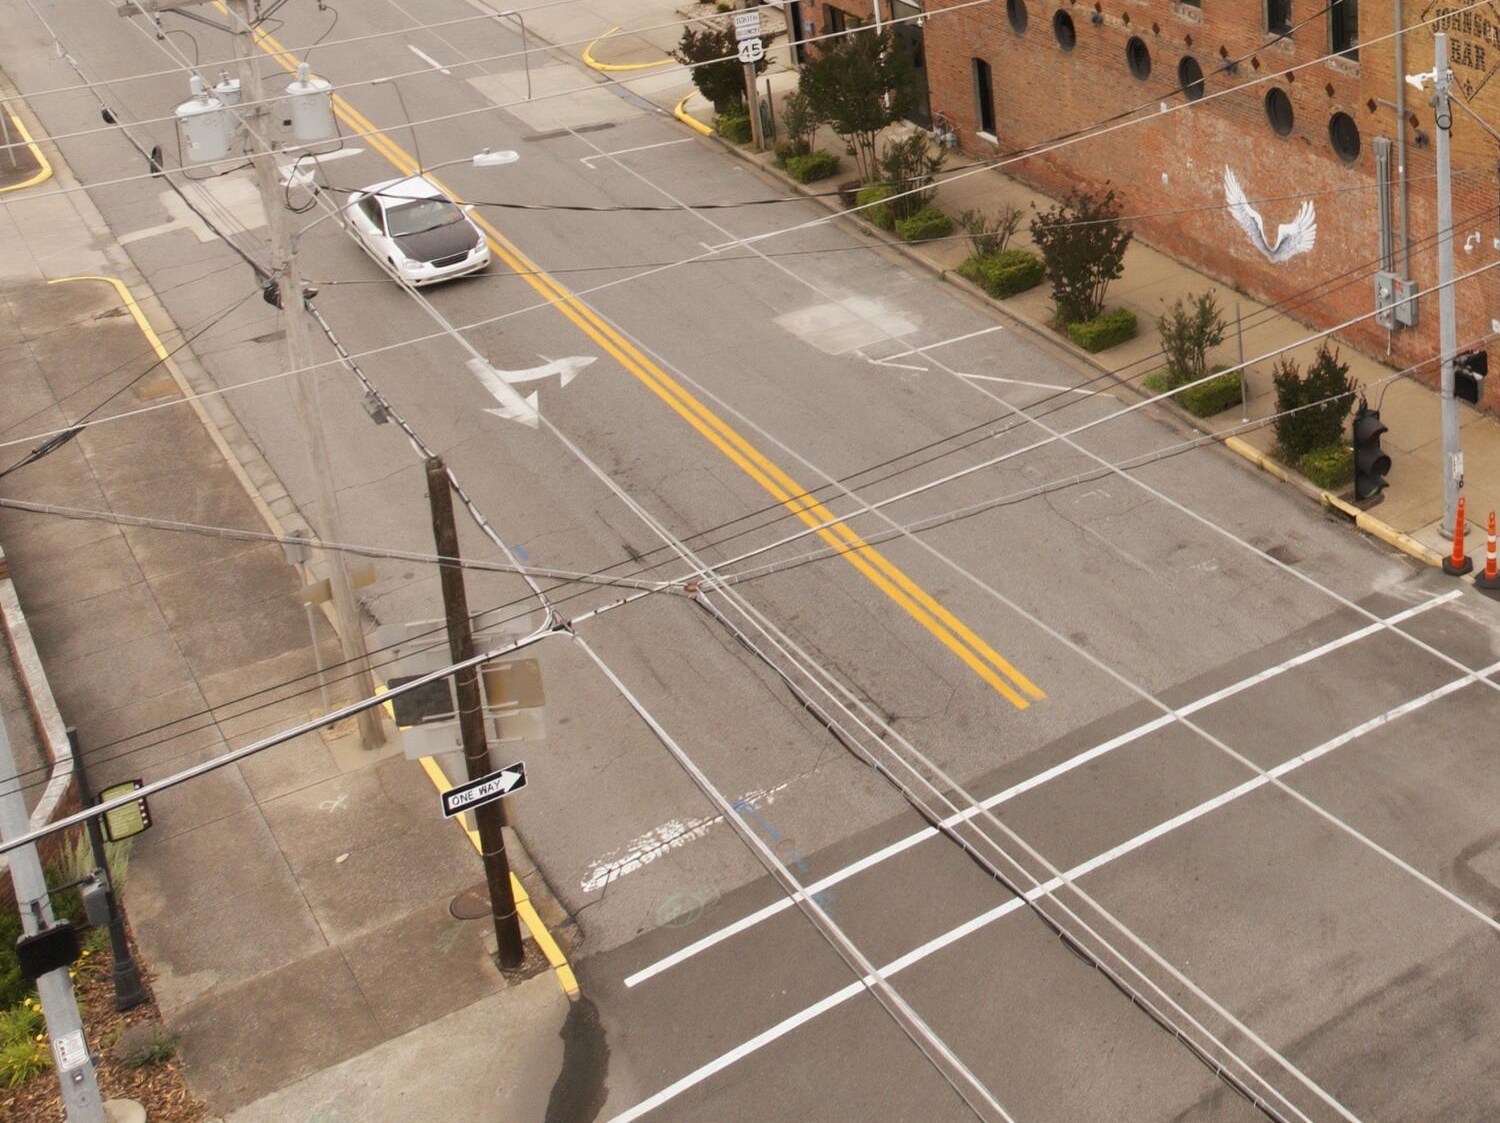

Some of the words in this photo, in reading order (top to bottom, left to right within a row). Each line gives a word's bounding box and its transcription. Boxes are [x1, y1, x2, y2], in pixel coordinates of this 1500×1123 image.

[742, 43, 761, 57] 45
[1450, 37, 1486, 72] BAR
[452, 791, 474, 806] ONE
[478, 779, 502, 796] WAY
